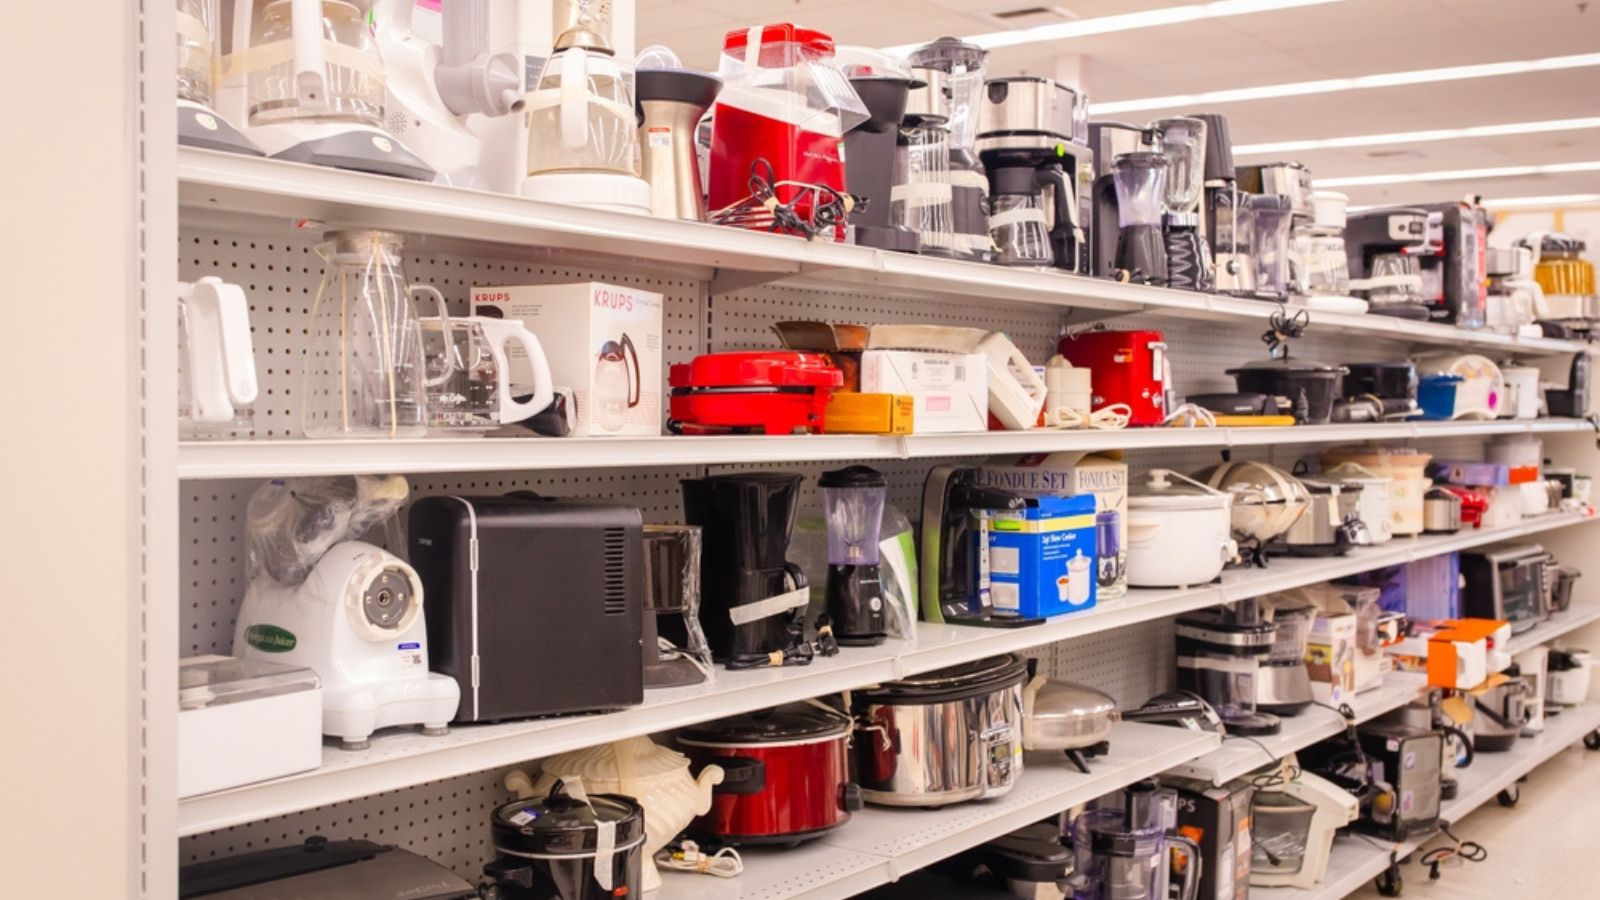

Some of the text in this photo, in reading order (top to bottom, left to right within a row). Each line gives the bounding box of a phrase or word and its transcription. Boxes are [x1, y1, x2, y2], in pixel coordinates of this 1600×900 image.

[474, 292, 511, 302] KRUPS
[594, 288, 633, 312] KRUPS
[987, 469, 1069, 489] FONDUE SET
[1079, 467, 1126, 488] FONDUE SET
